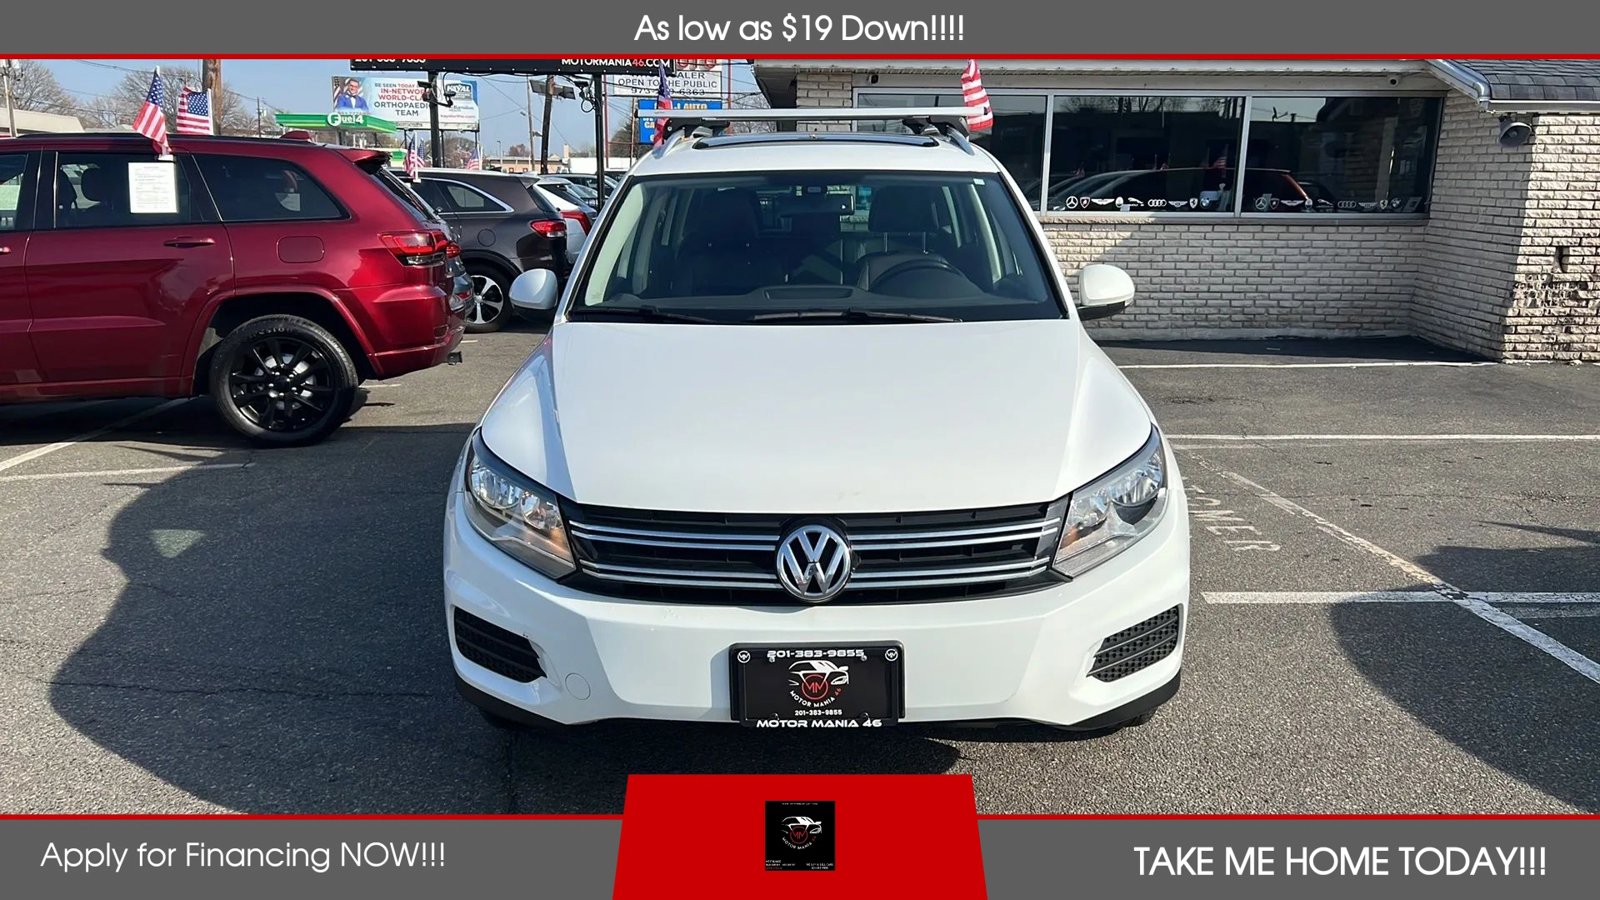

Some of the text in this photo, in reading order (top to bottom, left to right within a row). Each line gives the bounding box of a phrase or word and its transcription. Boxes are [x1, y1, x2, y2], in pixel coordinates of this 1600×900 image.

[676, 71, 706, 79] ALER
[683, 80, 718, 88] PUBLIC
[374, 101, 430, 109] ORTHOPAEDI
[766, 649, 865, 658] 201-383-9855
[790, 690, 812, 708] MOTOR
[813, 696, 836, 708] MANIA
[756, 719, 883, 728] MOTOR MANIA 46
